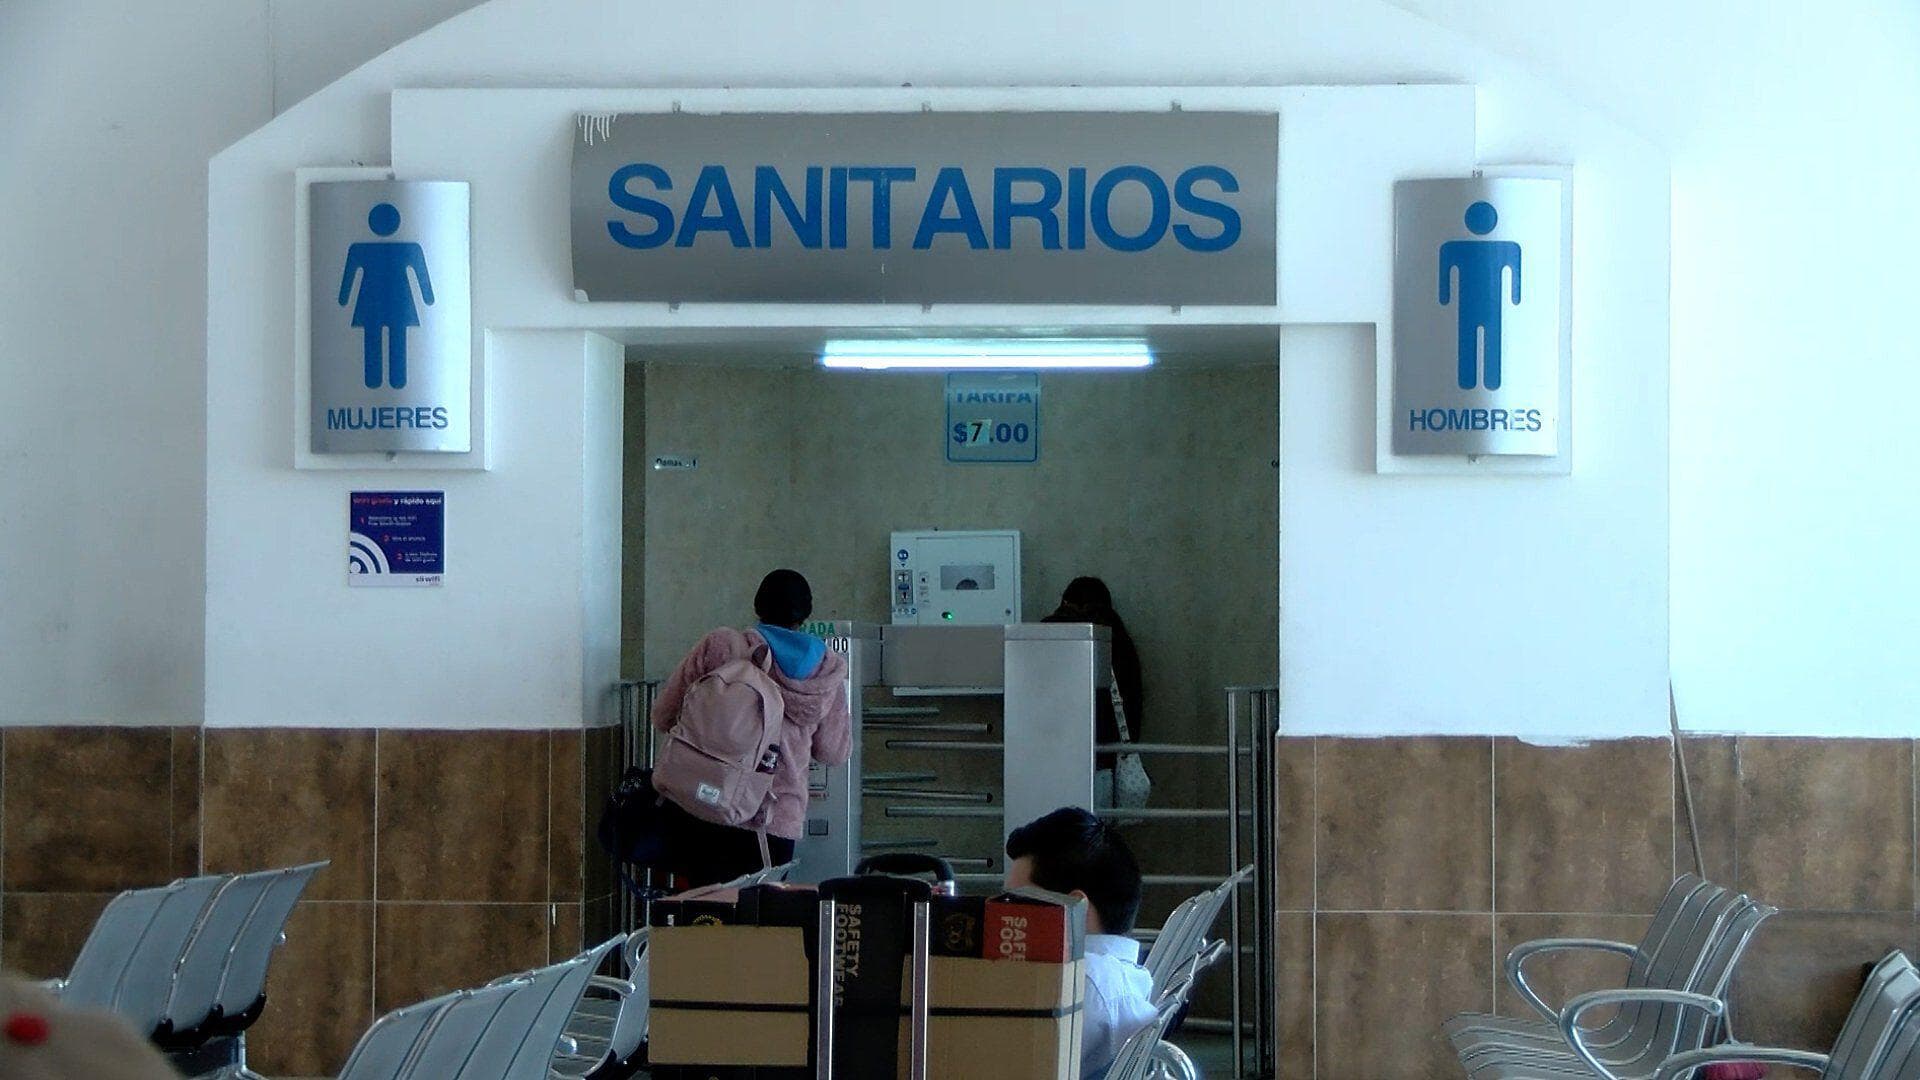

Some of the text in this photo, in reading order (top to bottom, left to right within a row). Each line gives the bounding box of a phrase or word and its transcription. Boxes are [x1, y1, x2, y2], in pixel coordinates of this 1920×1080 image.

[607, 163, 1242, 253] SANITARIOS
[327, 406, 448, 430] MUJERES
[1409, 408, 1542, 432] HOMBRES
[953, 422, 1029, 443] $7.00
[847, 904, 862, 978] SAFETY
